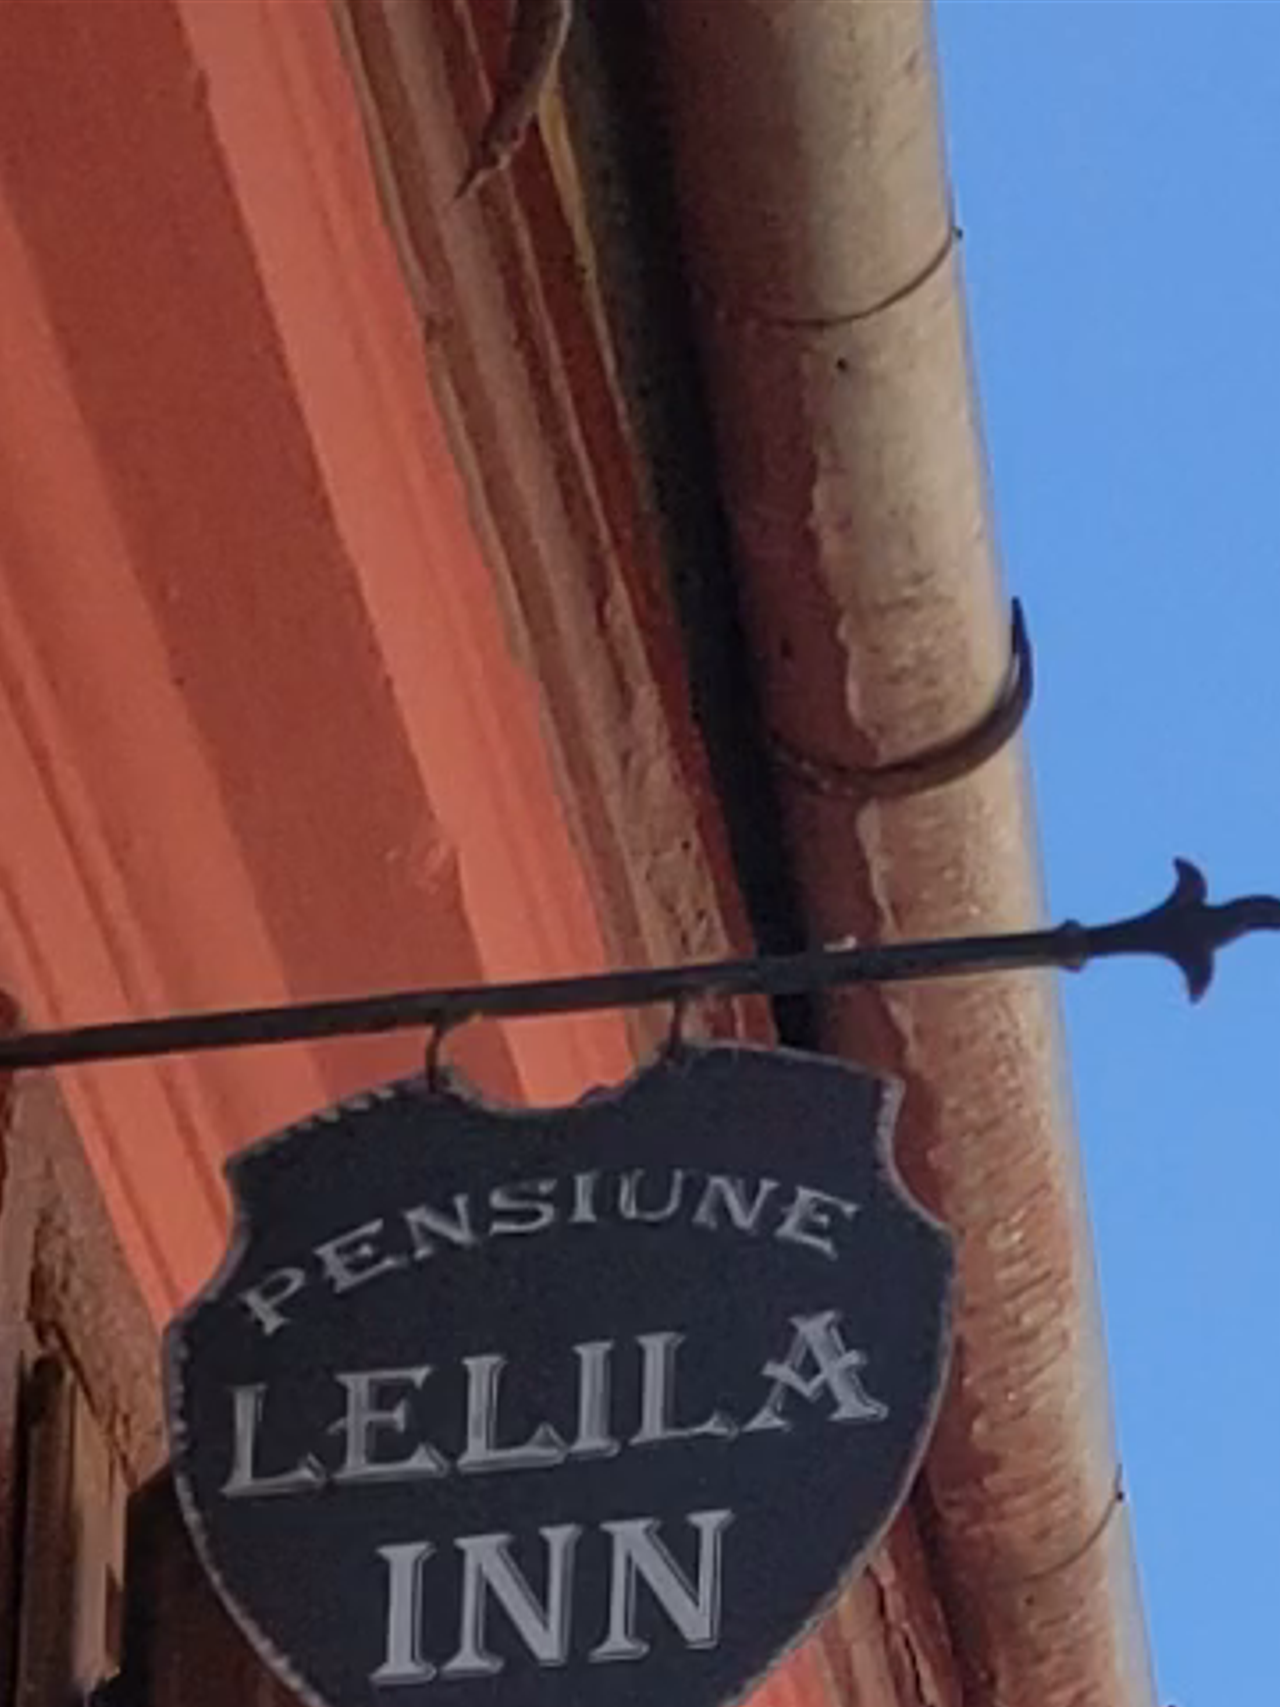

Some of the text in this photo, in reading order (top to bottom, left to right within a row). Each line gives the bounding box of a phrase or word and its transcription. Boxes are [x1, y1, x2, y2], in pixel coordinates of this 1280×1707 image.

[241, 1168, 861, 1334] PENSIUNE
[220, 1309, 888, 1498] LELILA
[370, 1508, 734, 1685] INN
